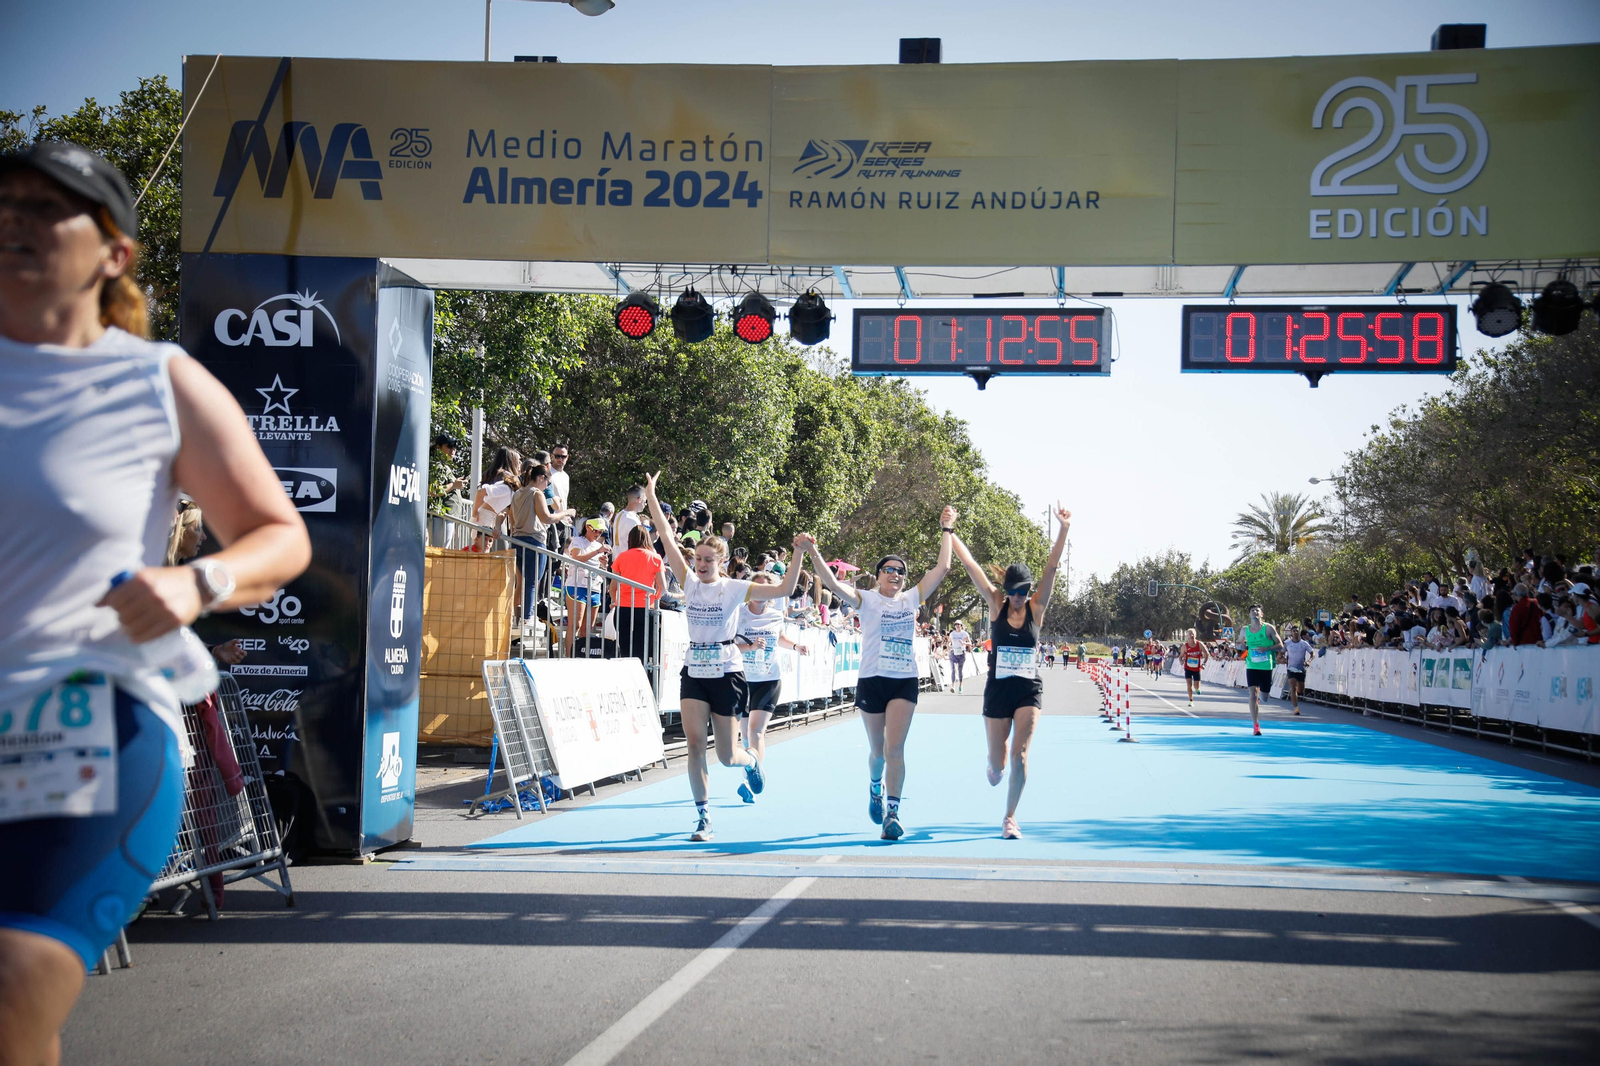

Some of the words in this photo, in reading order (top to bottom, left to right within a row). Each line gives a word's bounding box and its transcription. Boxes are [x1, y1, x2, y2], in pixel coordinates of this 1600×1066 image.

[389, 127, 433, 158] 25
[1309, 73, 1490, 198] 25
[465, 128, 582, 160] Medio
[601, 131, 763, 162] Maratón
[868, 142, 933, 154] RFEA
[388, 159, 432, 170] EDICIÓN
[862, 157, 925, 168] SERIES
[856, 169, 897, 179] RUTA
[900, 169, 962, 180] RUNNING
[462, 167, 633, 207] Almería
[643, 170, 763, 208] 2024
[789, 186, 886, 209] RAMÓN
[898, 191, 960, 209] RUIZ
[970, 187, 1100, 209] ANDÚJAR
[1308, 199, 1490, 241] EDICIÓN
[213, 308, 314, 347] CASI
[1225, 312, 1444, 364] 01:25:58
[246, 415, 341, 432] TRELLA
[258, 432, 312, 440] LEVANTE
[279, 480, 322, 499] EA
[388, 463, 421, 503] NEXAL
[279, 618, 291, 626] sport
[289, 639, 310, 655] 40
[384, 645, 409, 664] ALMERÍA
[692, 650, 720, 661] 5064
[883, 641, 912, 656] 5065
[1001, 652, 1032, 665] 5038
[231, 666, 242, 675] La
[242, 666, 259, 675] Voz
[260, 667, 271, 675] de
[272, 667, 307, 676] Almería
[232, 688, 303, 712] Coca-Cola
[232, 724, 301, 742] Adalucía
